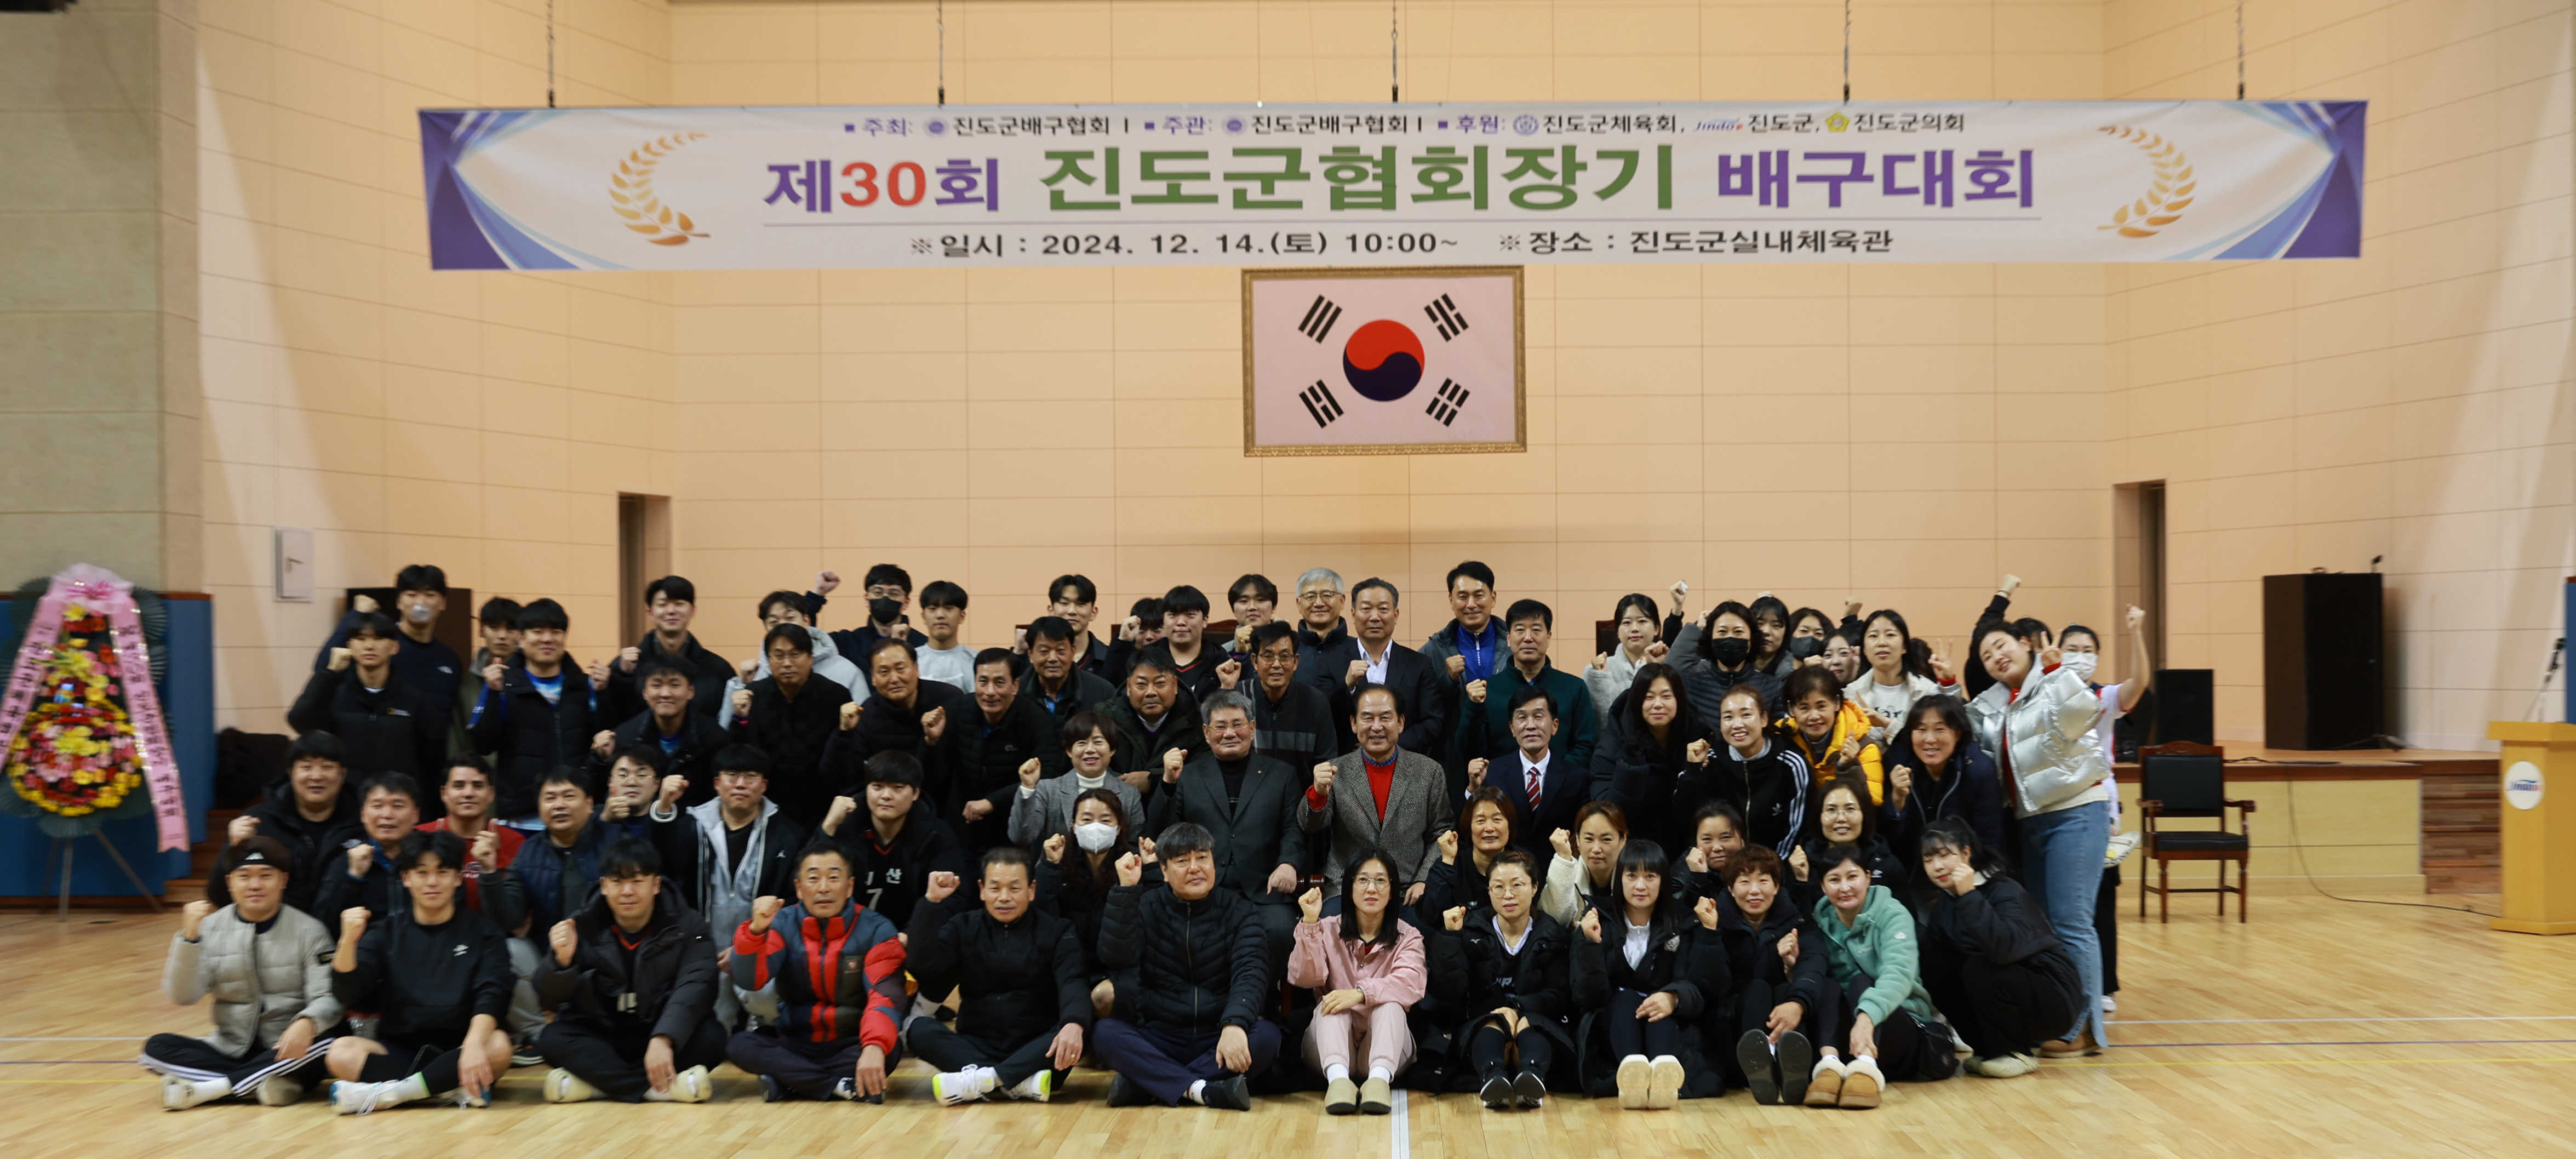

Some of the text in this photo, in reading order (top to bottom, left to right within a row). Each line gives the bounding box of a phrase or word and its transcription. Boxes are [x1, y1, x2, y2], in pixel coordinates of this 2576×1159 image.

[955, 116, 1110, 136] 진도군배구협회
[1253, 115, 1407, 134] 진도군배구협회
[1854, 113, 1964, 133] 진도군의회
[763, 144, 2034, 214] 제30회 진도군협회장기 배구대회
[1041, 234, 1134, 255] 2024.
[1150, 233, 1199, 254] 12.
[1630, 229, 1894, 254] 진도군실내체육관
